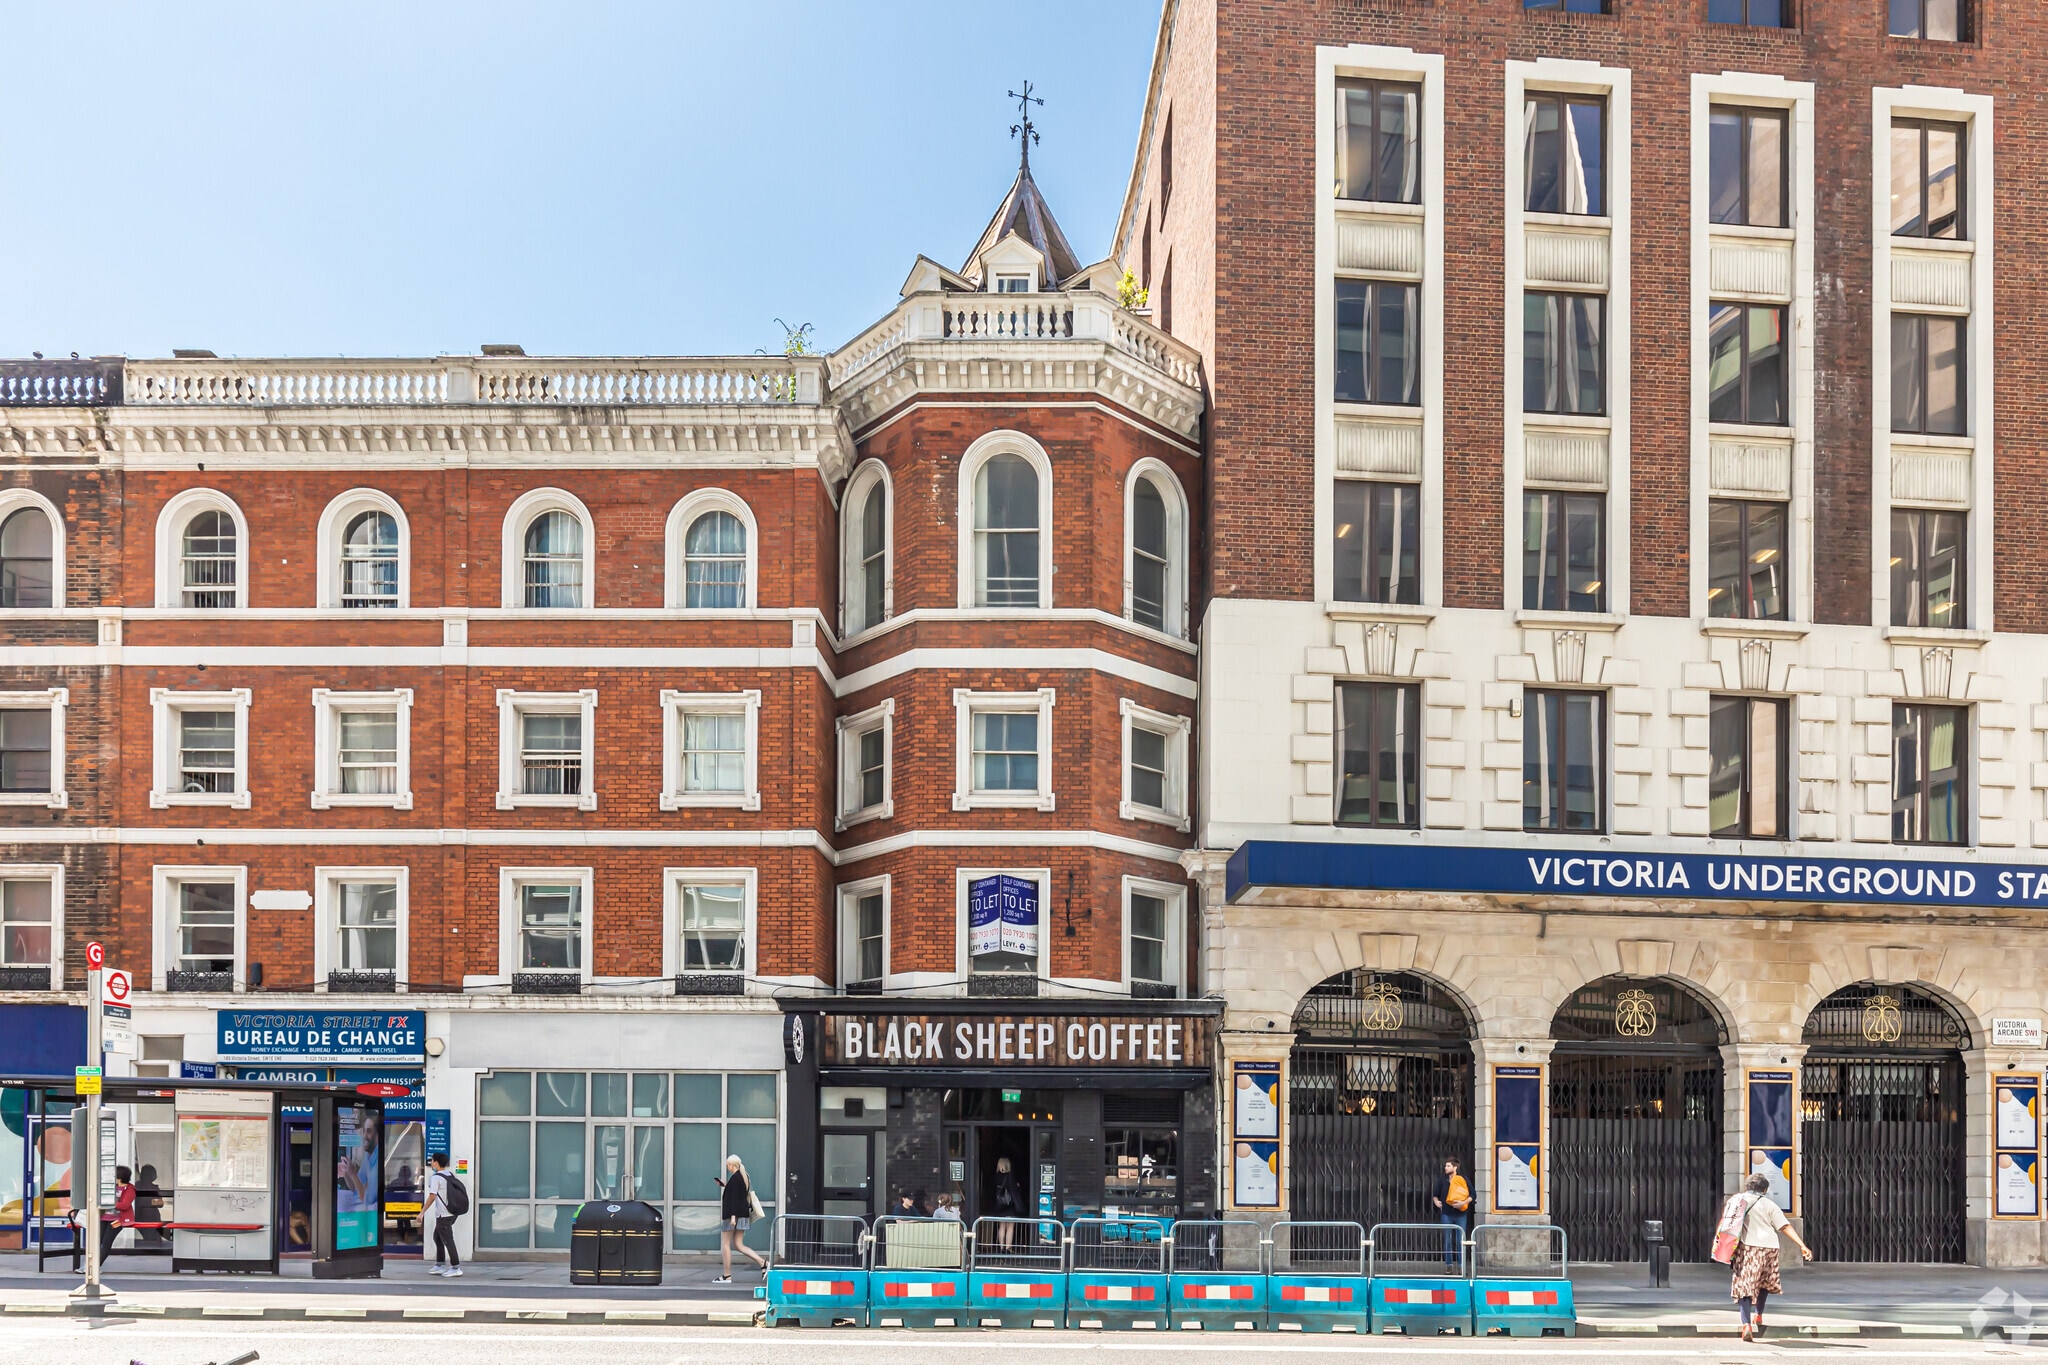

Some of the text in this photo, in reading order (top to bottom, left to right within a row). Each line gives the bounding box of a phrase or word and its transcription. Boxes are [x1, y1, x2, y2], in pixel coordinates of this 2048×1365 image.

[1003, 877, 1035, 890] SELF CONTAINED
[1528, 857, 2048, 900] VICTORIA UNDERGROUND STA
[1003, 885, 1019, 895] OFFICES
[970, 894, 999, 912] TO LET
[1003, 894, 1037, 912] TO LET
[1003, 928, 1012, 936] 020
[1013, 929, 1025, 938] 7930
[89, 945, 102, 962] G
[233, 1014, 409, 1028] VICTORIA STREET FX
[224, 1030, 416, 1045] BUREAU DE CHANGE
[845, 1022, 944, 1059] BLACK
[955, 1022, 1055, 1060] SHEEP
[1067, 1023, 1182, 1060] COFFEE
[184, 1062, 214, 1073] Bureau
[193, 1071, 205, 1079] De
[245, 1071, 317, 1081] CAMBIO
[371, 1077, 418, 1085] COMMISSIO
